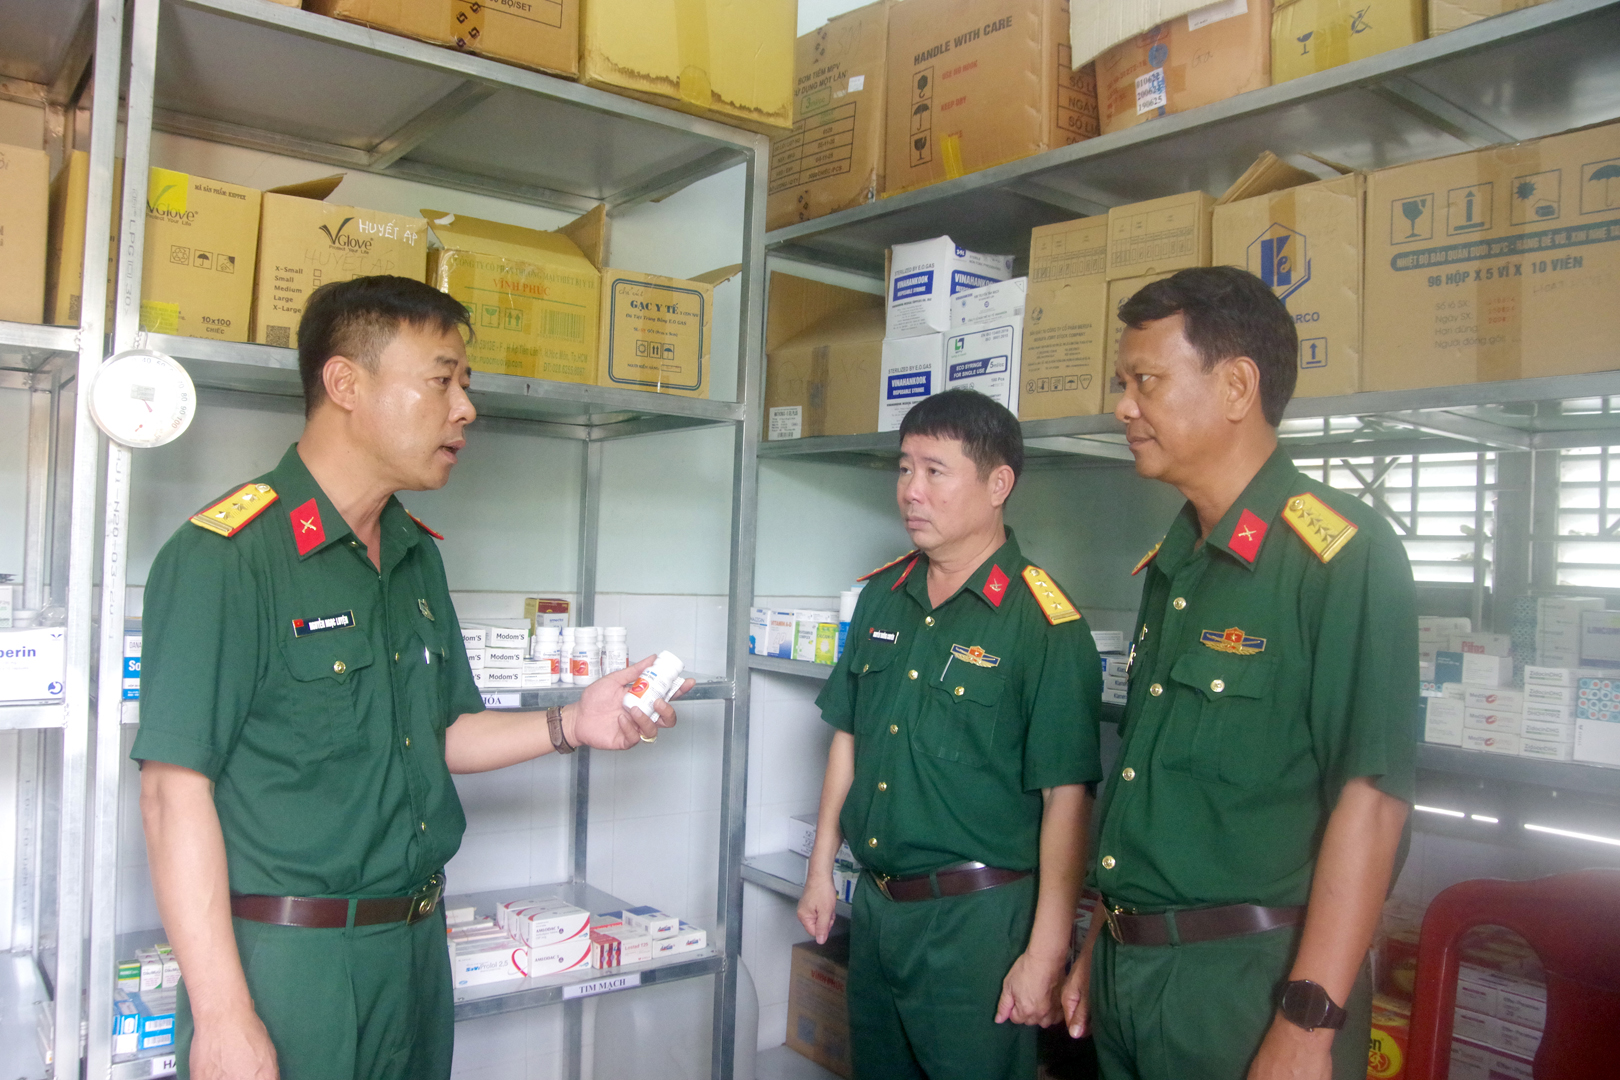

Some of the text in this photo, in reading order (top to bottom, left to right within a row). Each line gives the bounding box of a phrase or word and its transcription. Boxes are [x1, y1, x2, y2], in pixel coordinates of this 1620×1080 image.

[914, 15, 1013, 66] HANDLE WITH CARE
[359, 218, 399, 240] HUYẾT
[275, 265, 303, 275] X-Small
[1427, 275, 1442, 287] 96
[1445, 269, 1470, 287] HỘP
[1474, 268, 1482, 281] X
[1486, 267, 1494, 280] 5
[1514, 263, 1522, 276] X
[1531, 260, 1547, 274] 10
[1551, 254, 1583, 271] VIÊN
[274, 275, 294, 283] Small
[274, 285, 302, 294] Medium
[273, 295, 293, 303] Large
[273, 304, 302, 314] X-Large
[630, 299, 679, 315] GẠC Y TẾ
[201, 315, 231, 327] 10x100
[962, 369, 976, 377] SINGLE
[891, 375, 927, 388] VINAHANKOOK
[496, 633, 525, 641] Modom'S
[579, 978, 627, 994] TIM MẠCH
